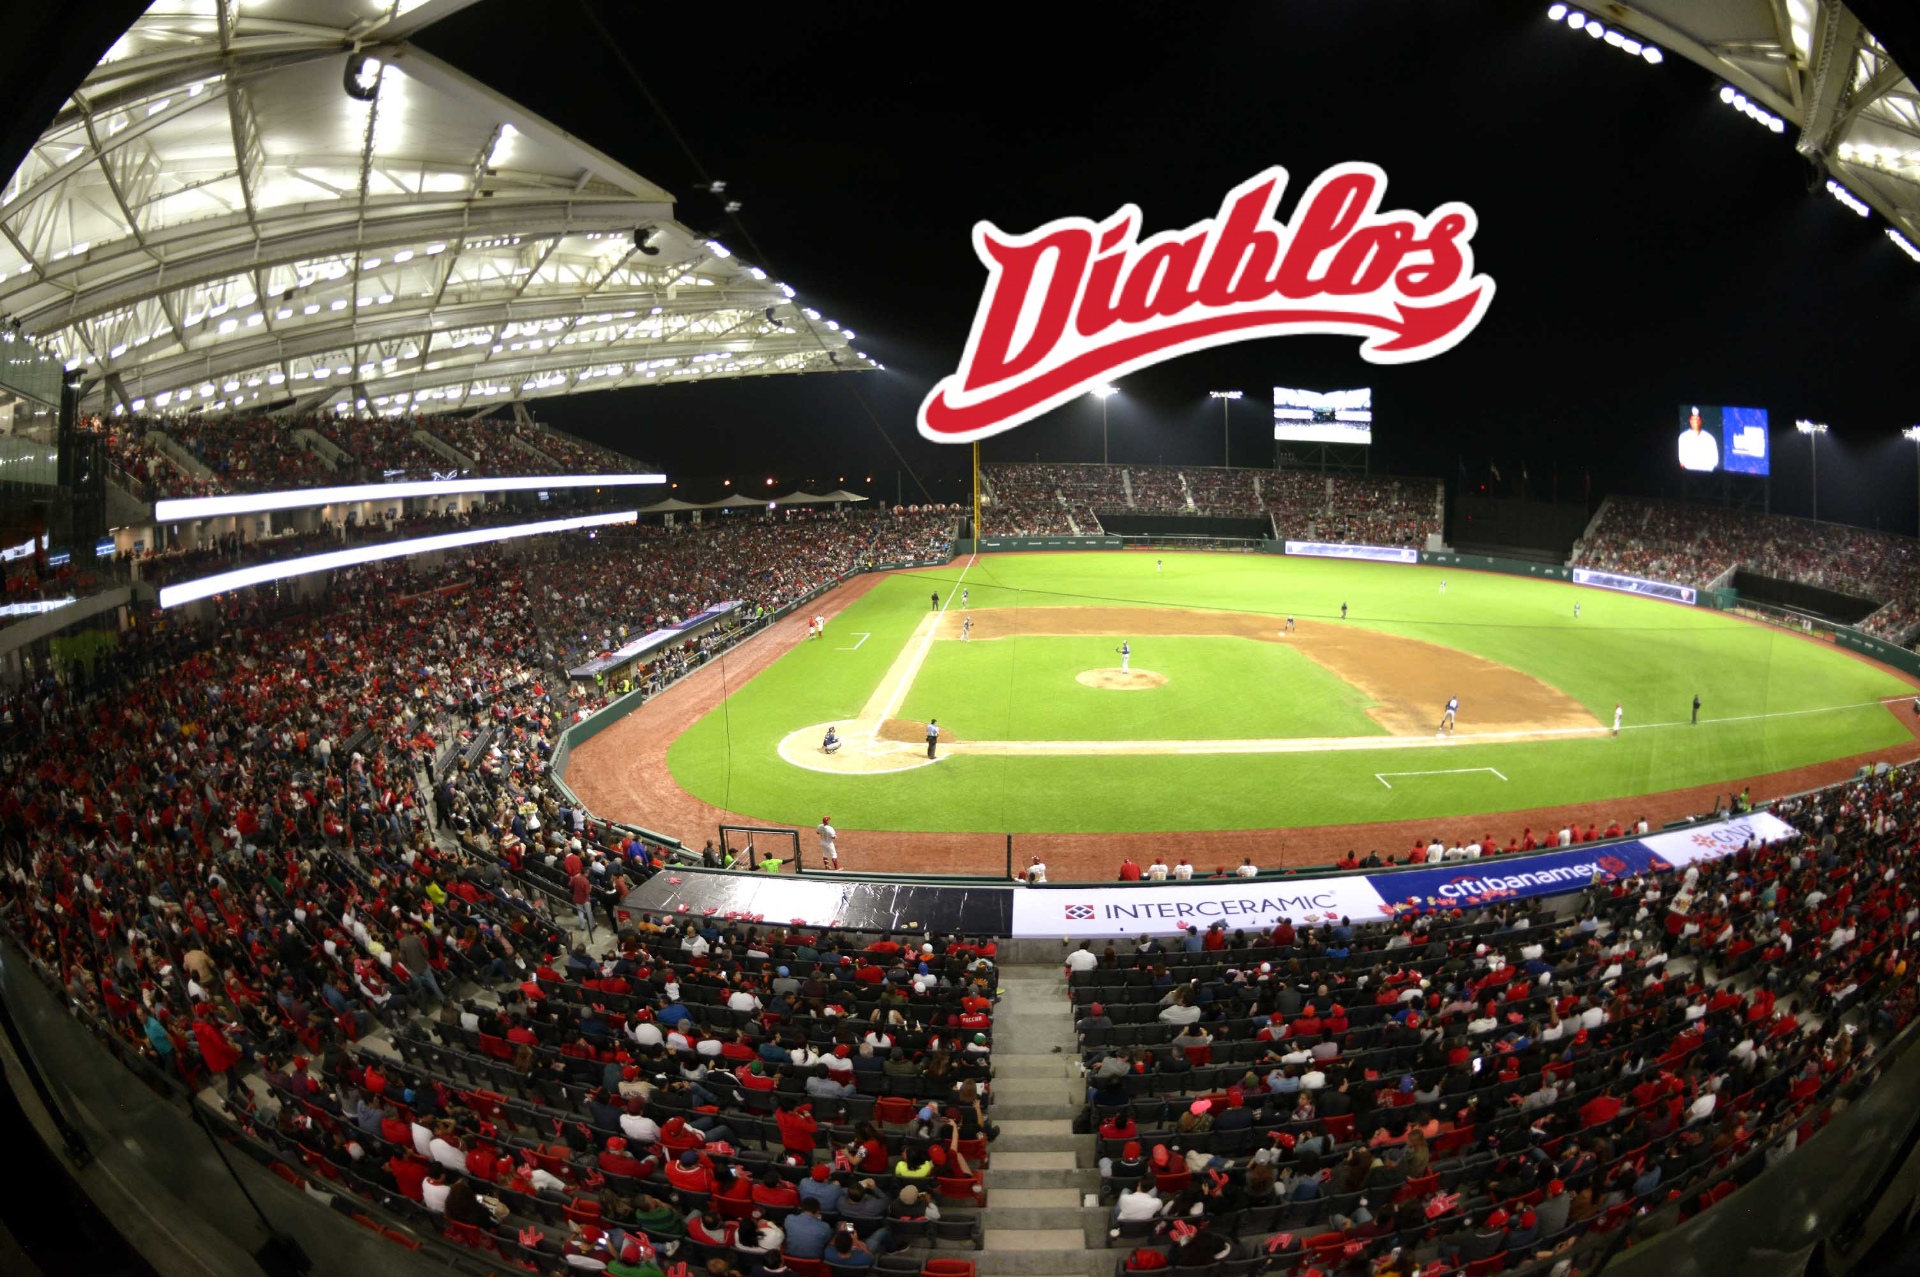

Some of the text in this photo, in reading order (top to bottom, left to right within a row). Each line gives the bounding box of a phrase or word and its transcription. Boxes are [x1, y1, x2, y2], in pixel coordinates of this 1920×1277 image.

[1711, 824, 1754, 843] GNP
[1438, 861, 1606, 898] citibanamex
[1104, 894, 1338, 919] INTERCERAMIC
